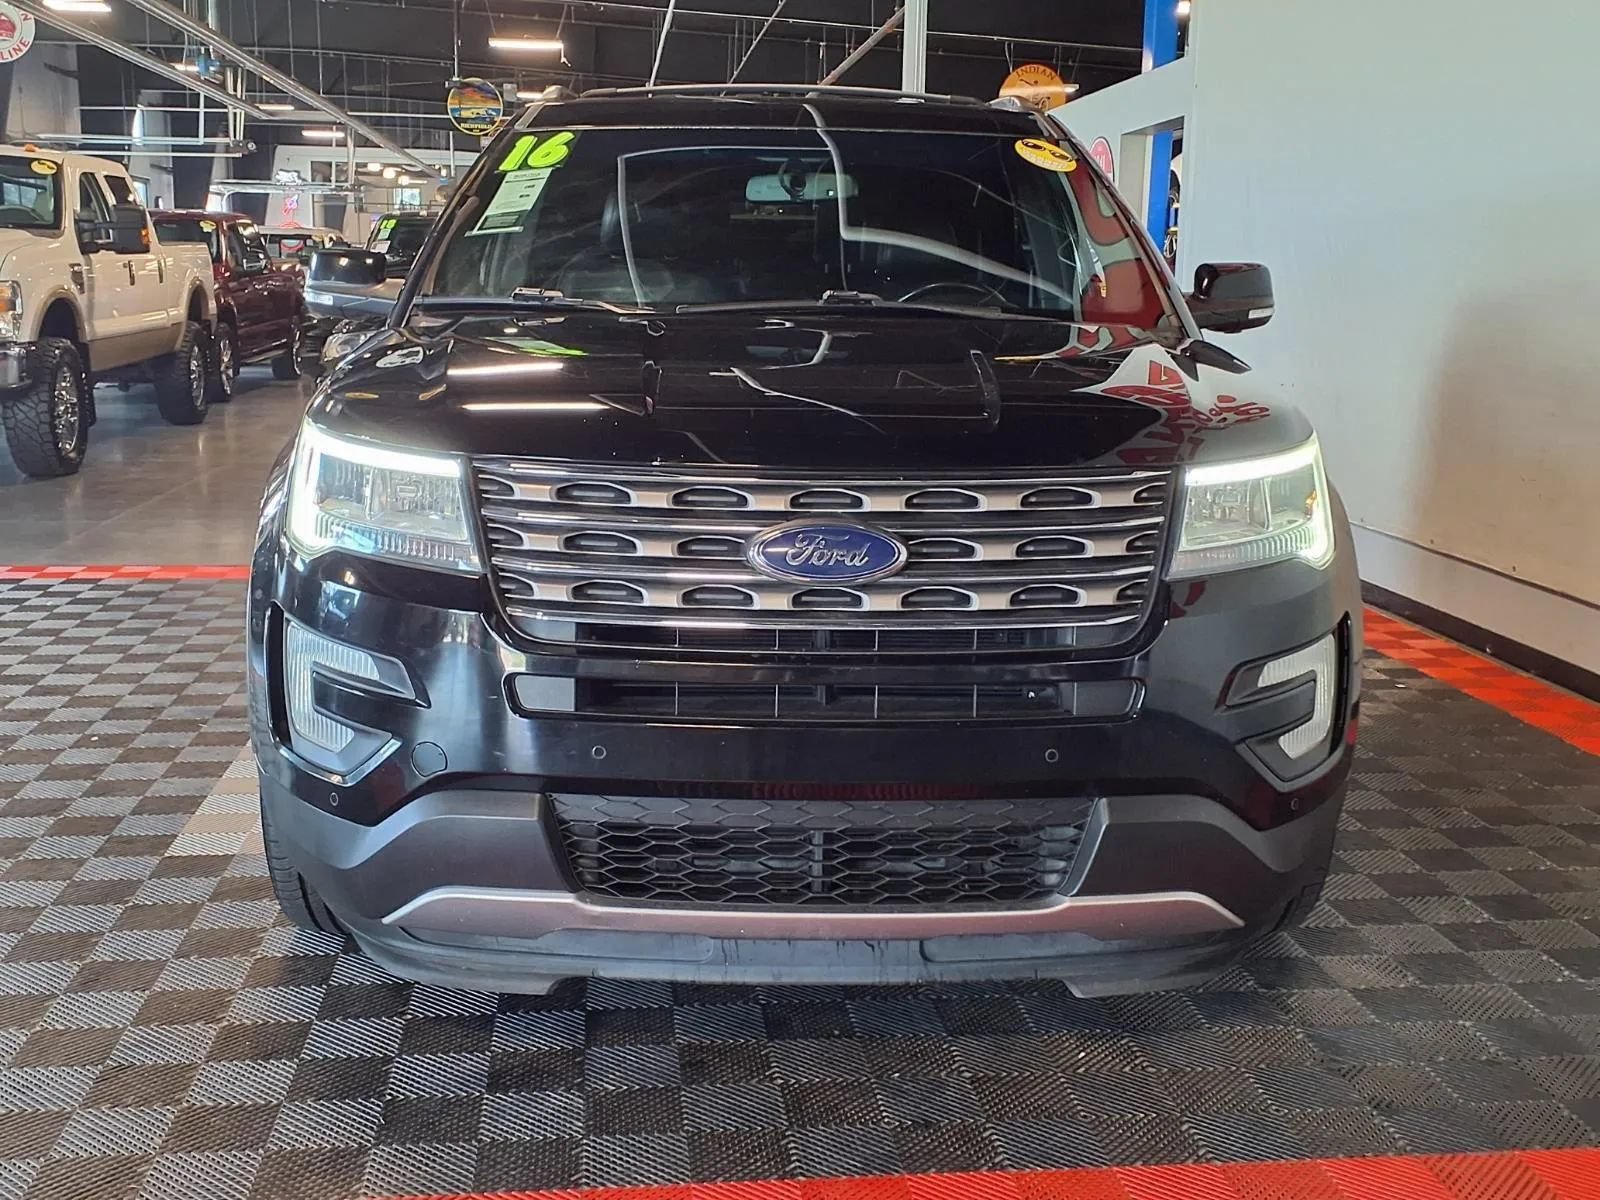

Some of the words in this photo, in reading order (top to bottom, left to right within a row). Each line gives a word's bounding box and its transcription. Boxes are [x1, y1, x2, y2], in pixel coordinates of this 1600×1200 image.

[1016, 66, 1056, 80] INDIAN
[498, 131, 575, 171] 16
[786, 533, 871, 567] Ford
